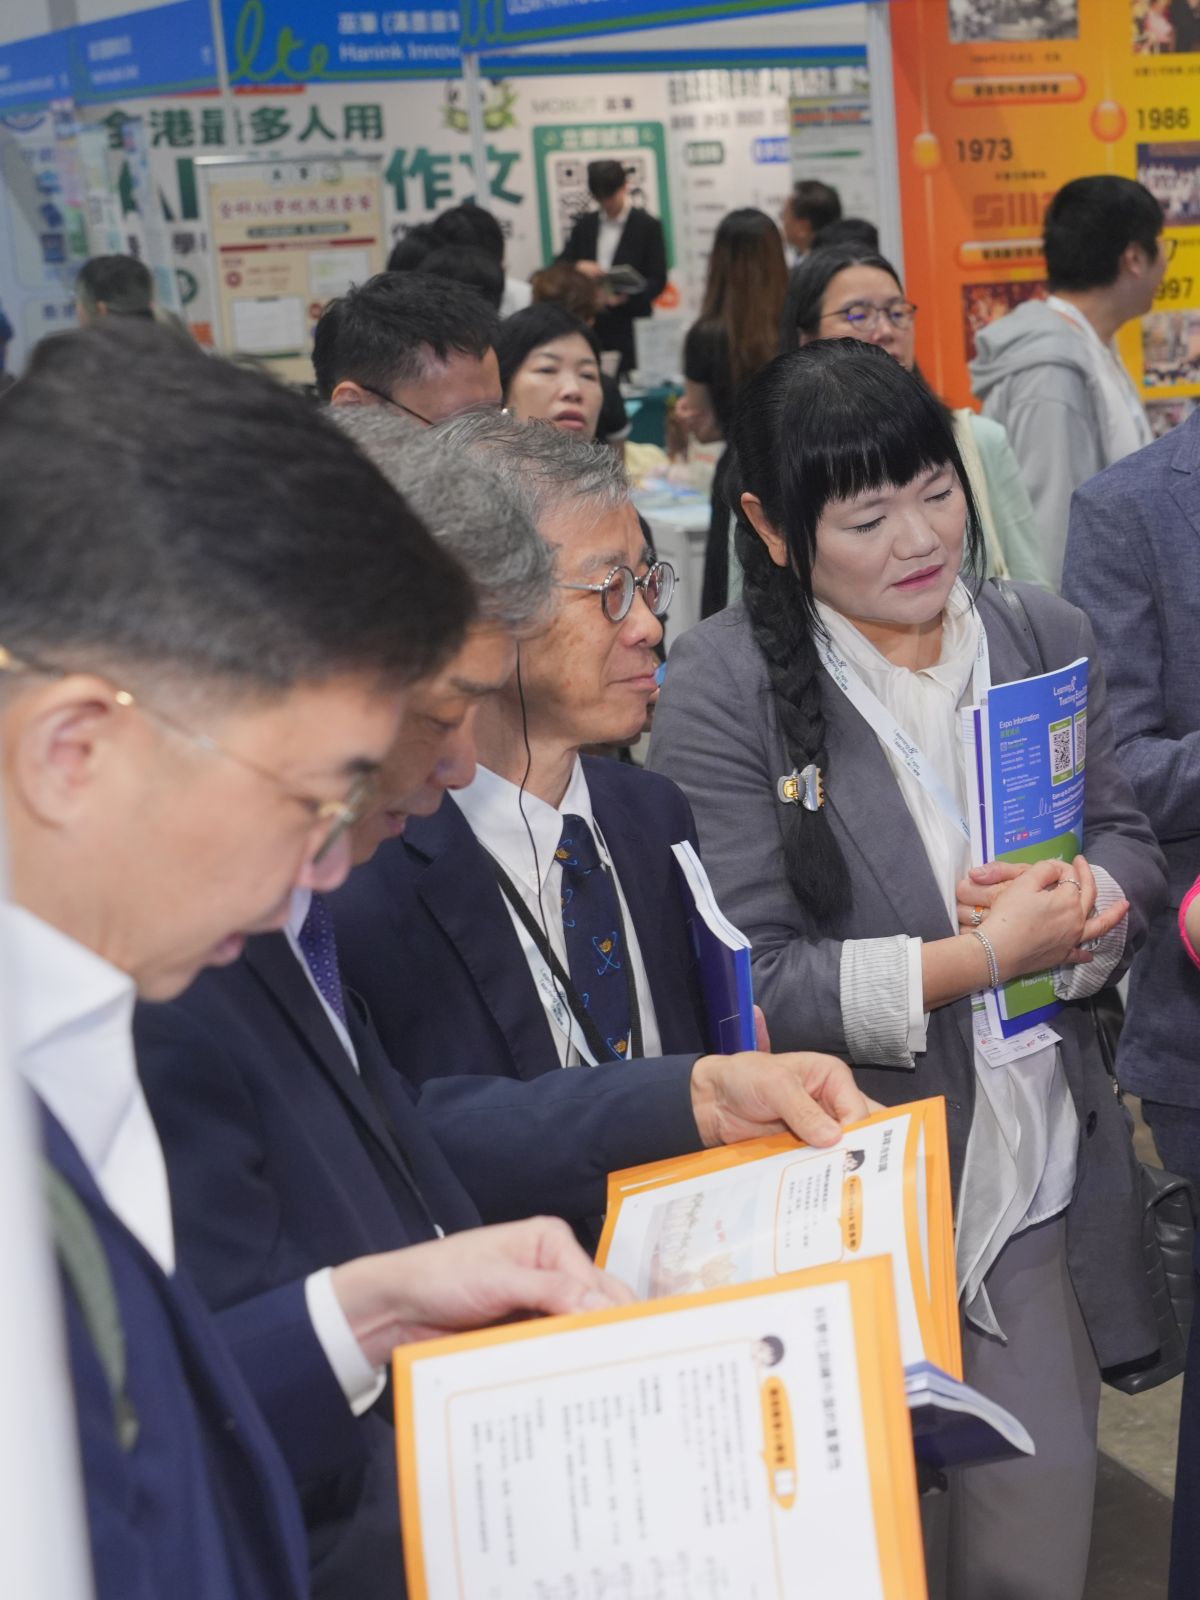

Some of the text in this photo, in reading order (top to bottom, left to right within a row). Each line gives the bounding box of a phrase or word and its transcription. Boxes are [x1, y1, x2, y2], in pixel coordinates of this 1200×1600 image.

[1137, 108, 1190, 130] 1986
[956, 139, 1013, 162] 1973
[1156, 277, 1194, 300] 997
[999, 712, 1040, 730] Expo Information
